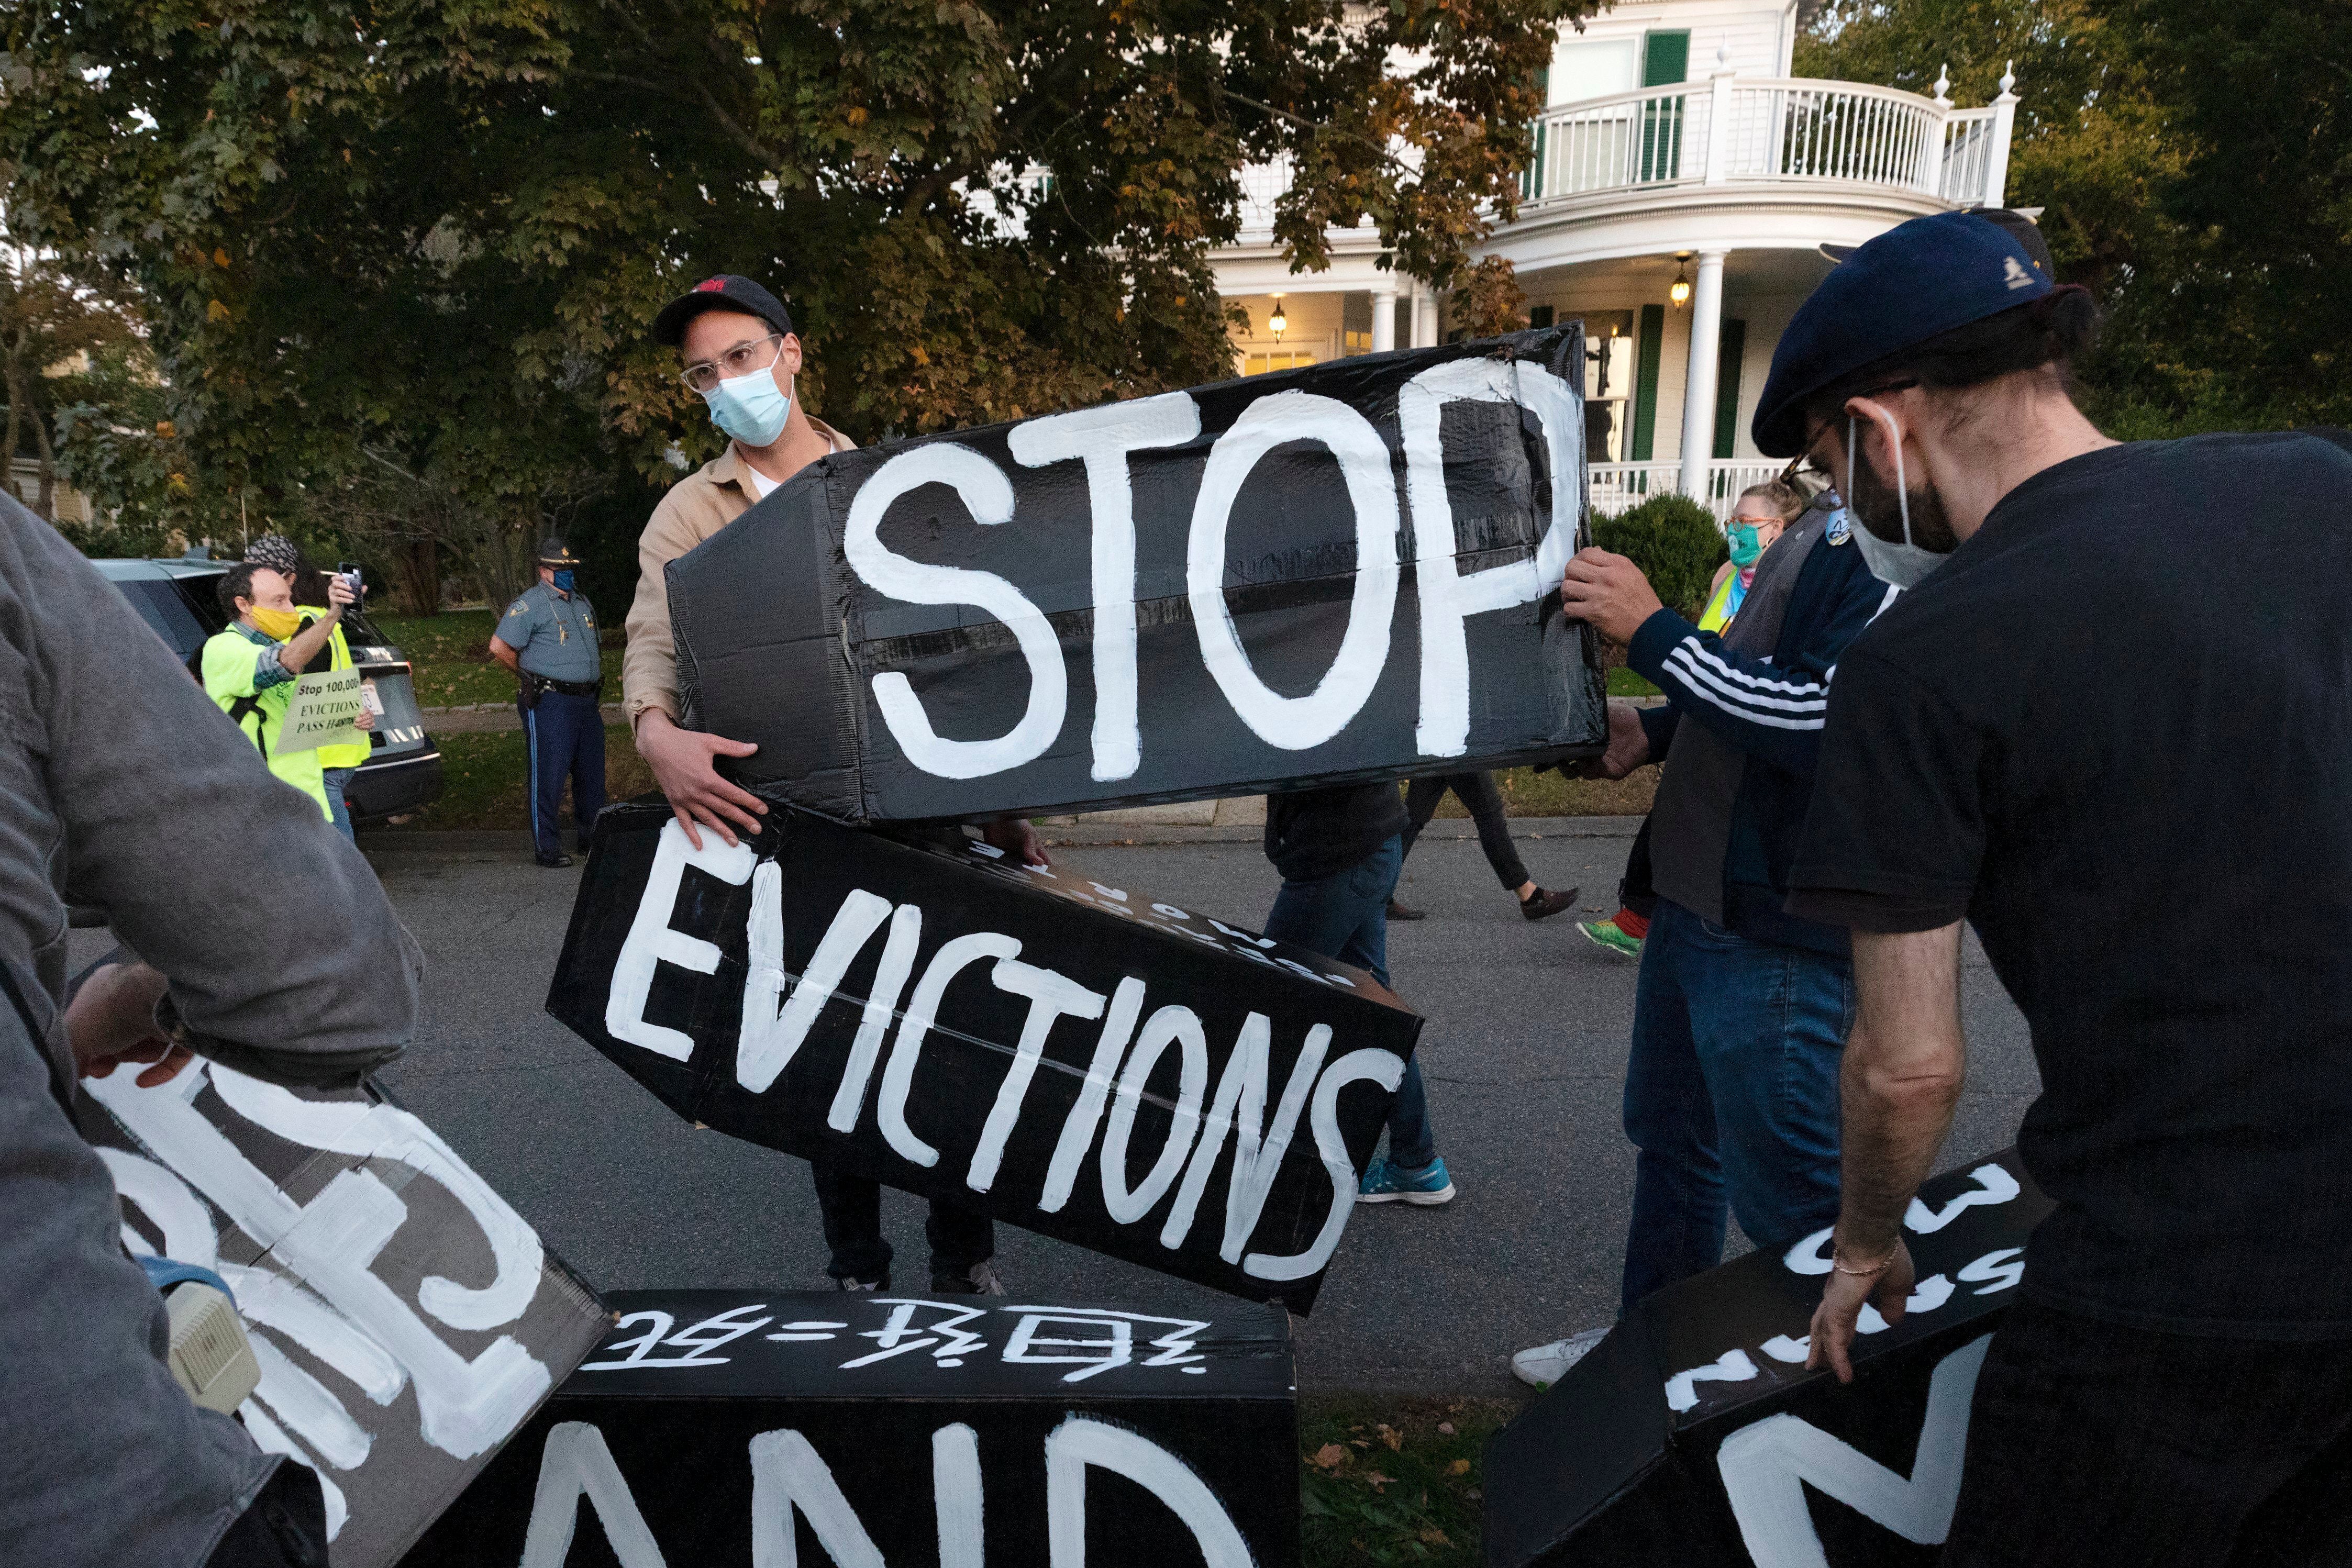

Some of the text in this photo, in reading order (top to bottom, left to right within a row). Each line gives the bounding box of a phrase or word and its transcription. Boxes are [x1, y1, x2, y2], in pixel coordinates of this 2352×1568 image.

[844, 356, 1585, 782] STOP
[298, 685, 321, 696] Stop
[301, 699, 360, 717] EVICTIONS
[297, 719, 324, 733] PASS
[969, 840, 1278, 949] MORTE
[604, 816, 1406, 1281] EVICTIONS
